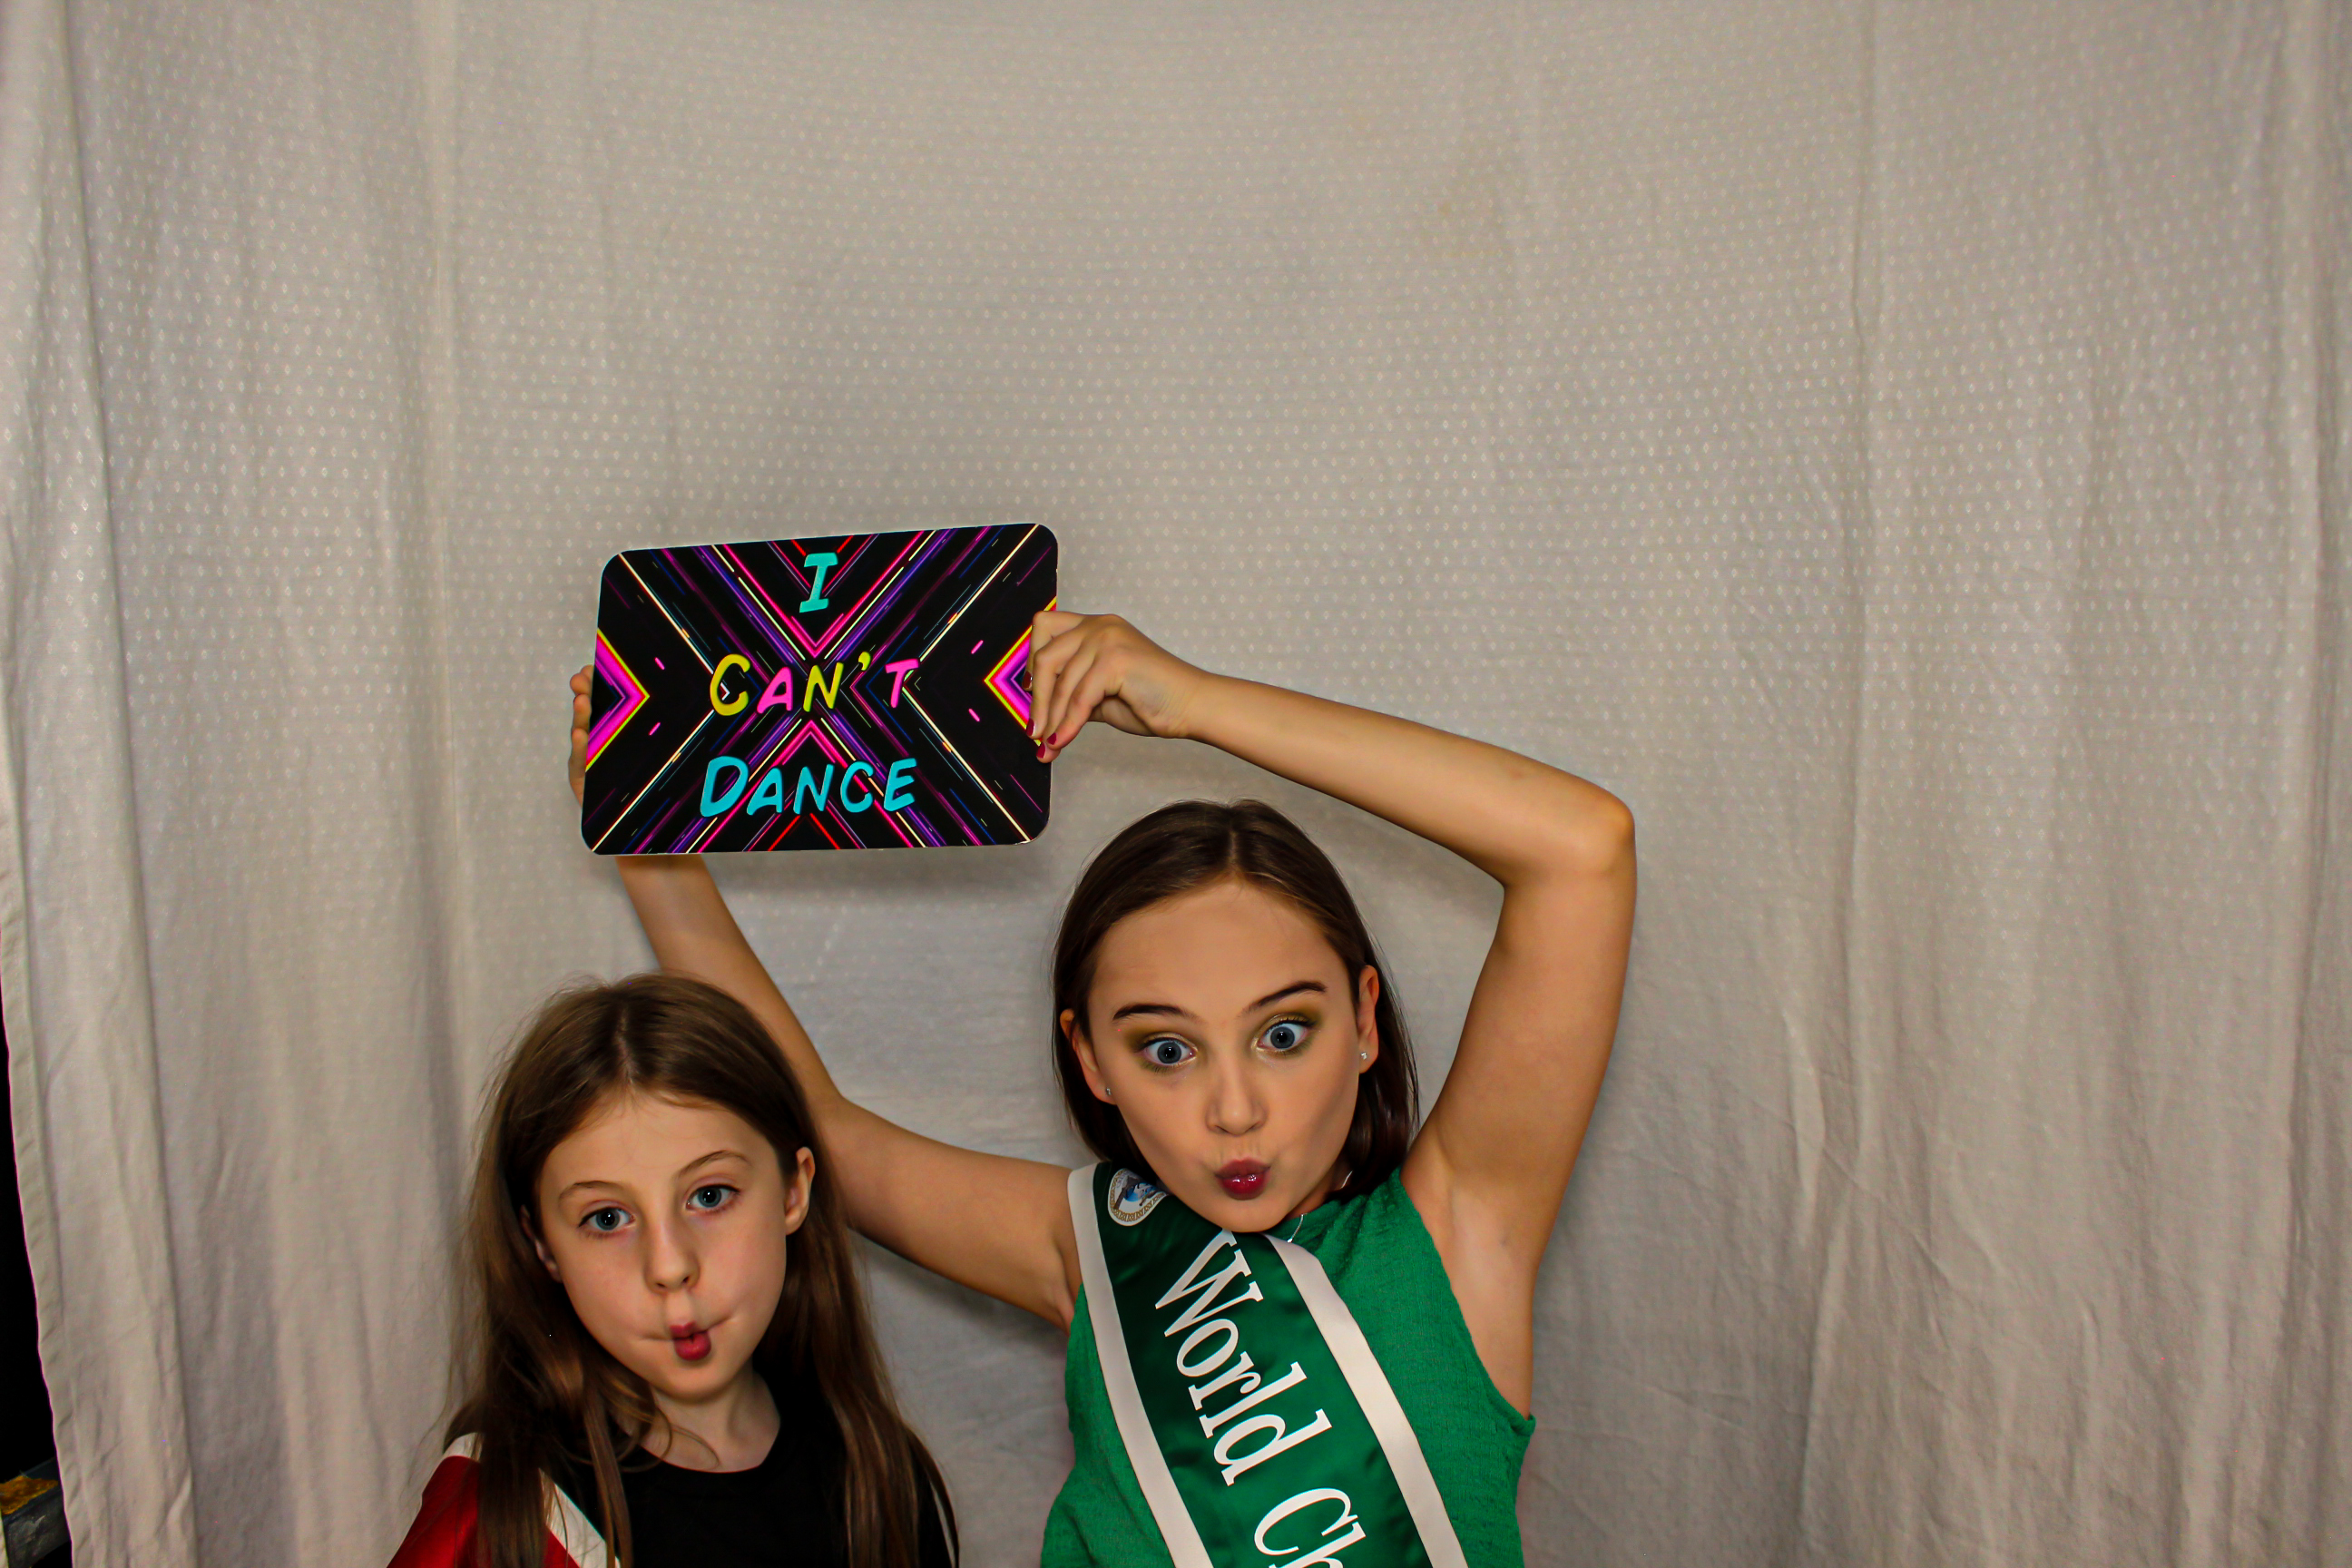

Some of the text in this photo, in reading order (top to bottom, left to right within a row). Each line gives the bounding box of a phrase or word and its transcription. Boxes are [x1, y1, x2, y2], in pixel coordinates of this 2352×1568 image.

[799, 553, 838, 612] I
[710, 652, 918, 715] CAN'T
[700, 756, 917, 818] DANCE
[1155, 1229, 1332, 1486] World
